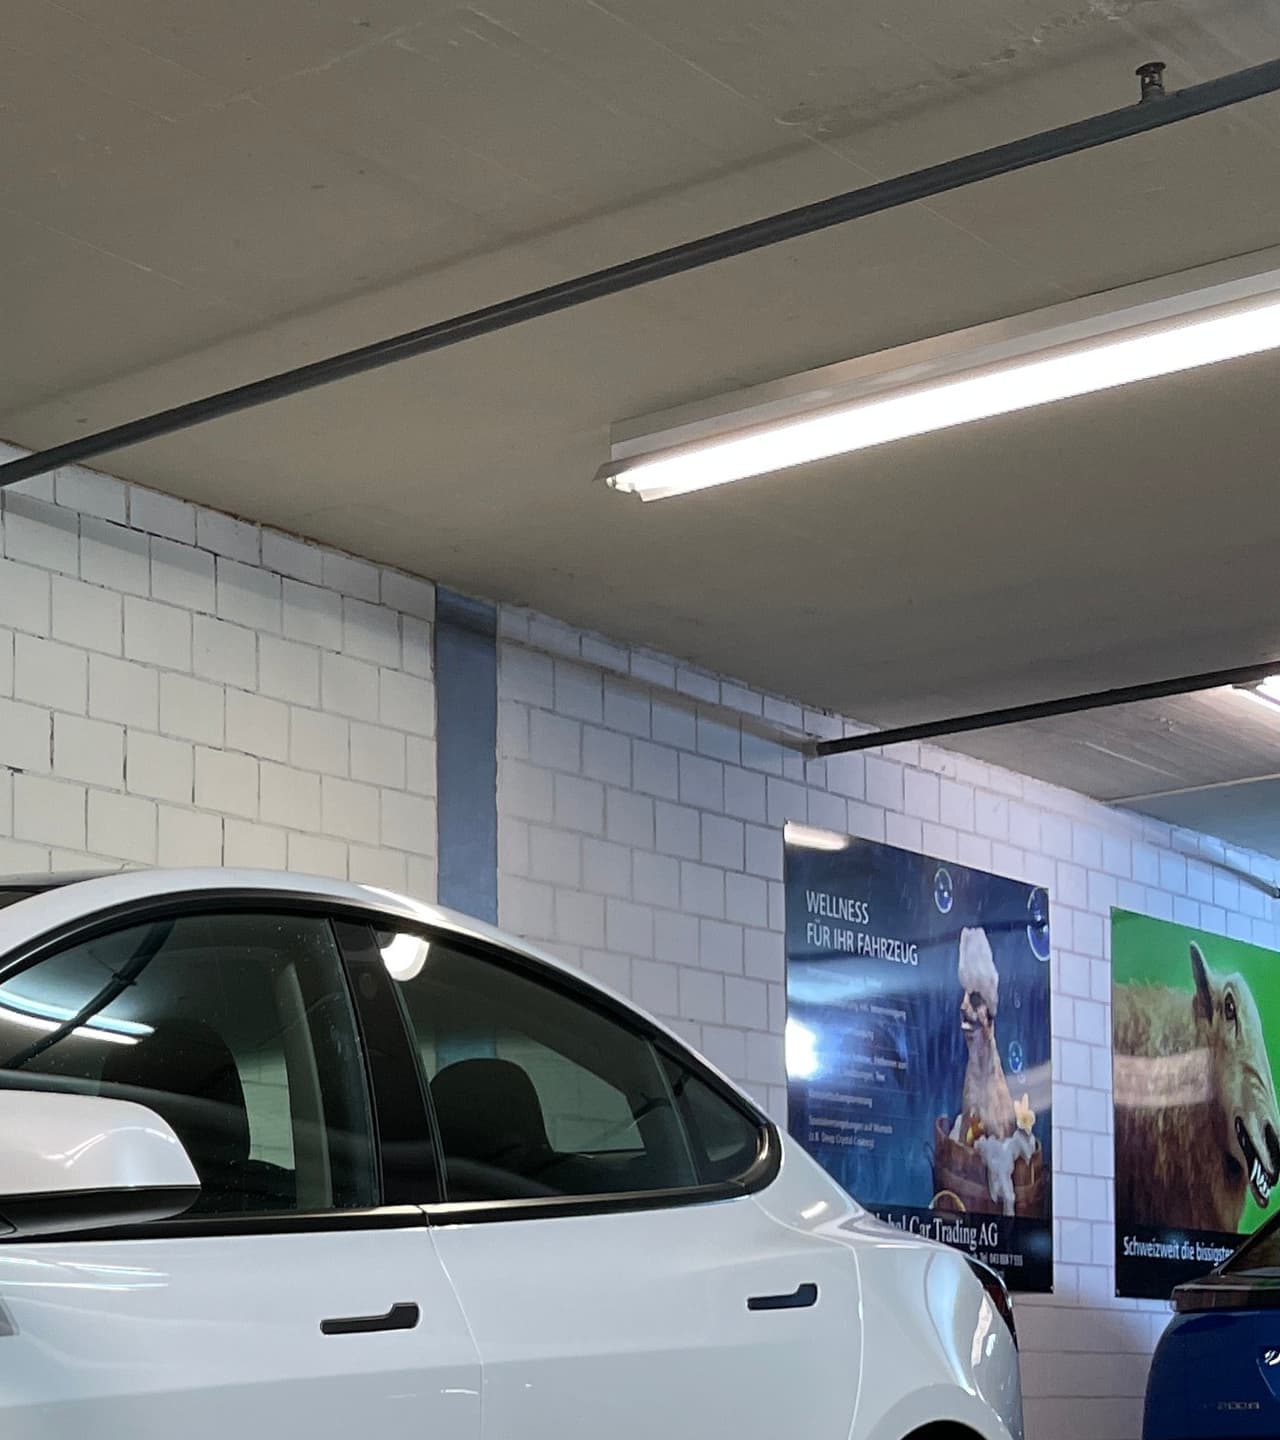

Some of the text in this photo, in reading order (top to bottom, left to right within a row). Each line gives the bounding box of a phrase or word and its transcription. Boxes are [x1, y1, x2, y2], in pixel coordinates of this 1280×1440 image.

[806, 890, 869, 925] WELLNESS
[807, 918, 918, 966] FÜR IHR FAHRZEUG
[909, 1215, 931, 1241] Car
[933, 1217, 977, 1251] Trading
[979, 1222, 999, 1248] AG
[1123, 1235, 1180, 1260] Schweizweit
[1181, 1240, 1194, 1261] die
